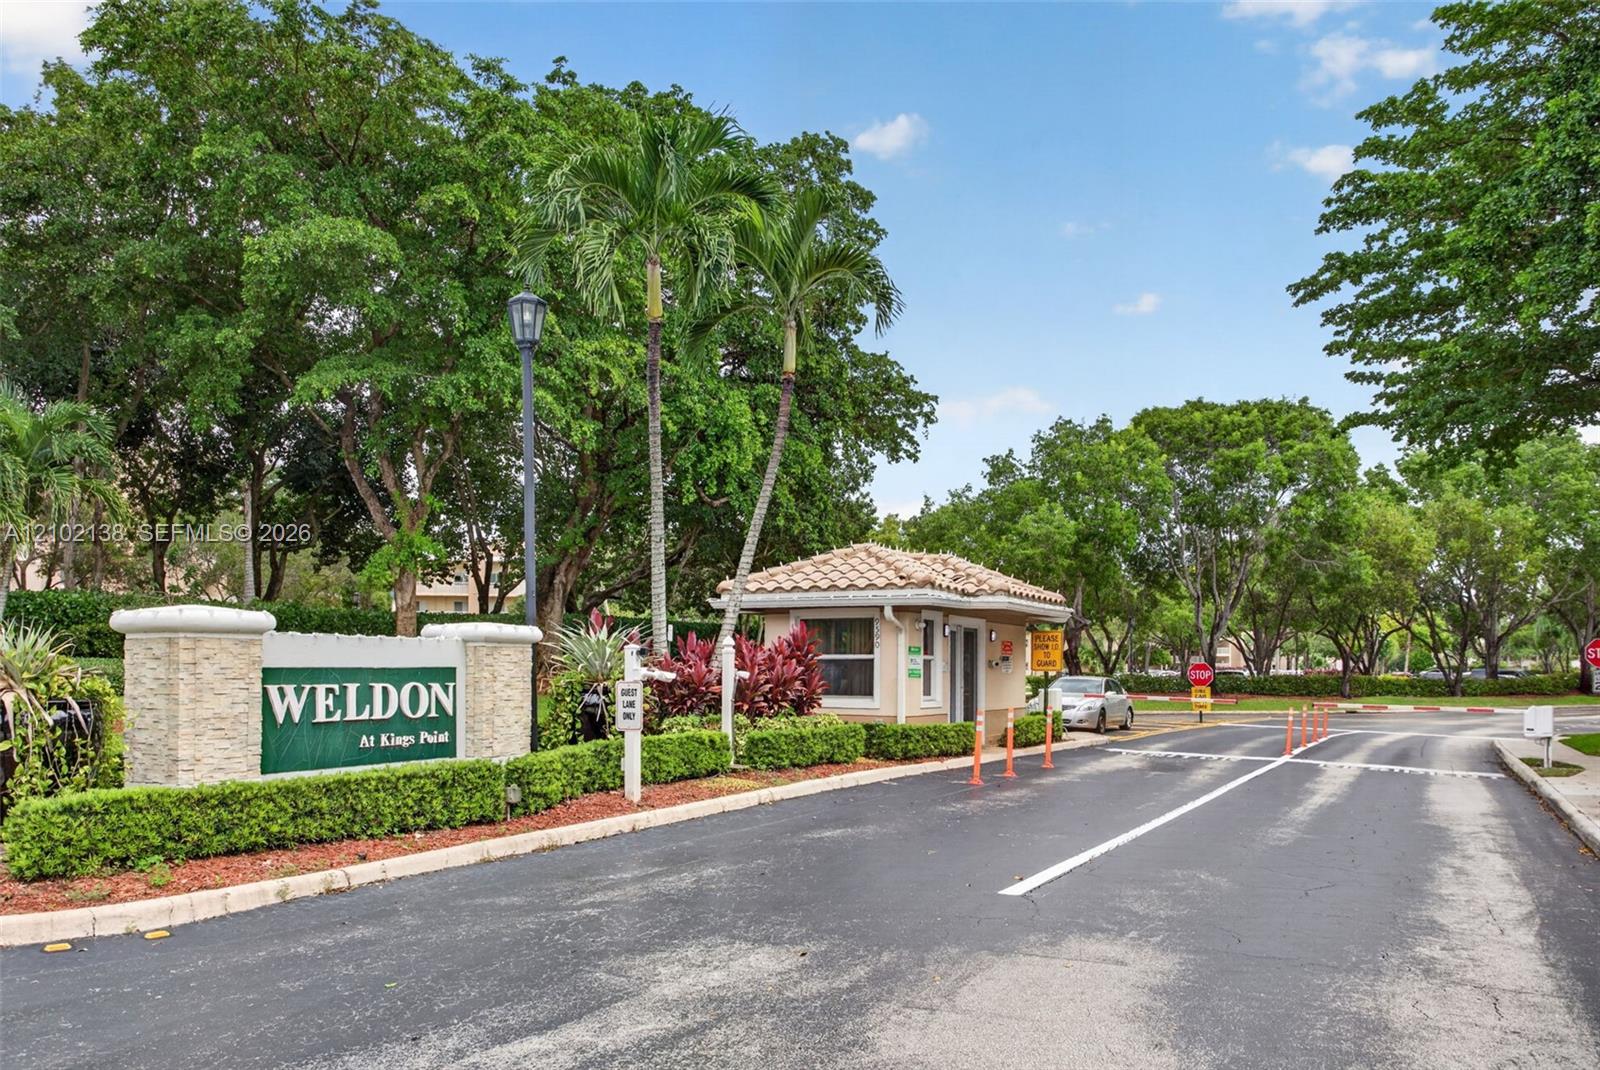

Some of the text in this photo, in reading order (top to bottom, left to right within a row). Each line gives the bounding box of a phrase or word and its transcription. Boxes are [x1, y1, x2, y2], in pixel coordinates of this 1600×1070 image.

[1034, 634, 1059, 642] PLEASE
[1043, 651, 1051, 659] TO
[1588, 648, 1600, 659] ST
[1036, 659, 1057, 667] GUARD
[1190, 670, 1210, 680] STOP
[621, 688, 637, 696] GUEST
[263, 681, 456, 727] WELDON
[622, 700, 636, 708] LANE
[622, 712, 635, 720] ONLY
[359, 730, 449, 748] At Kings Point
